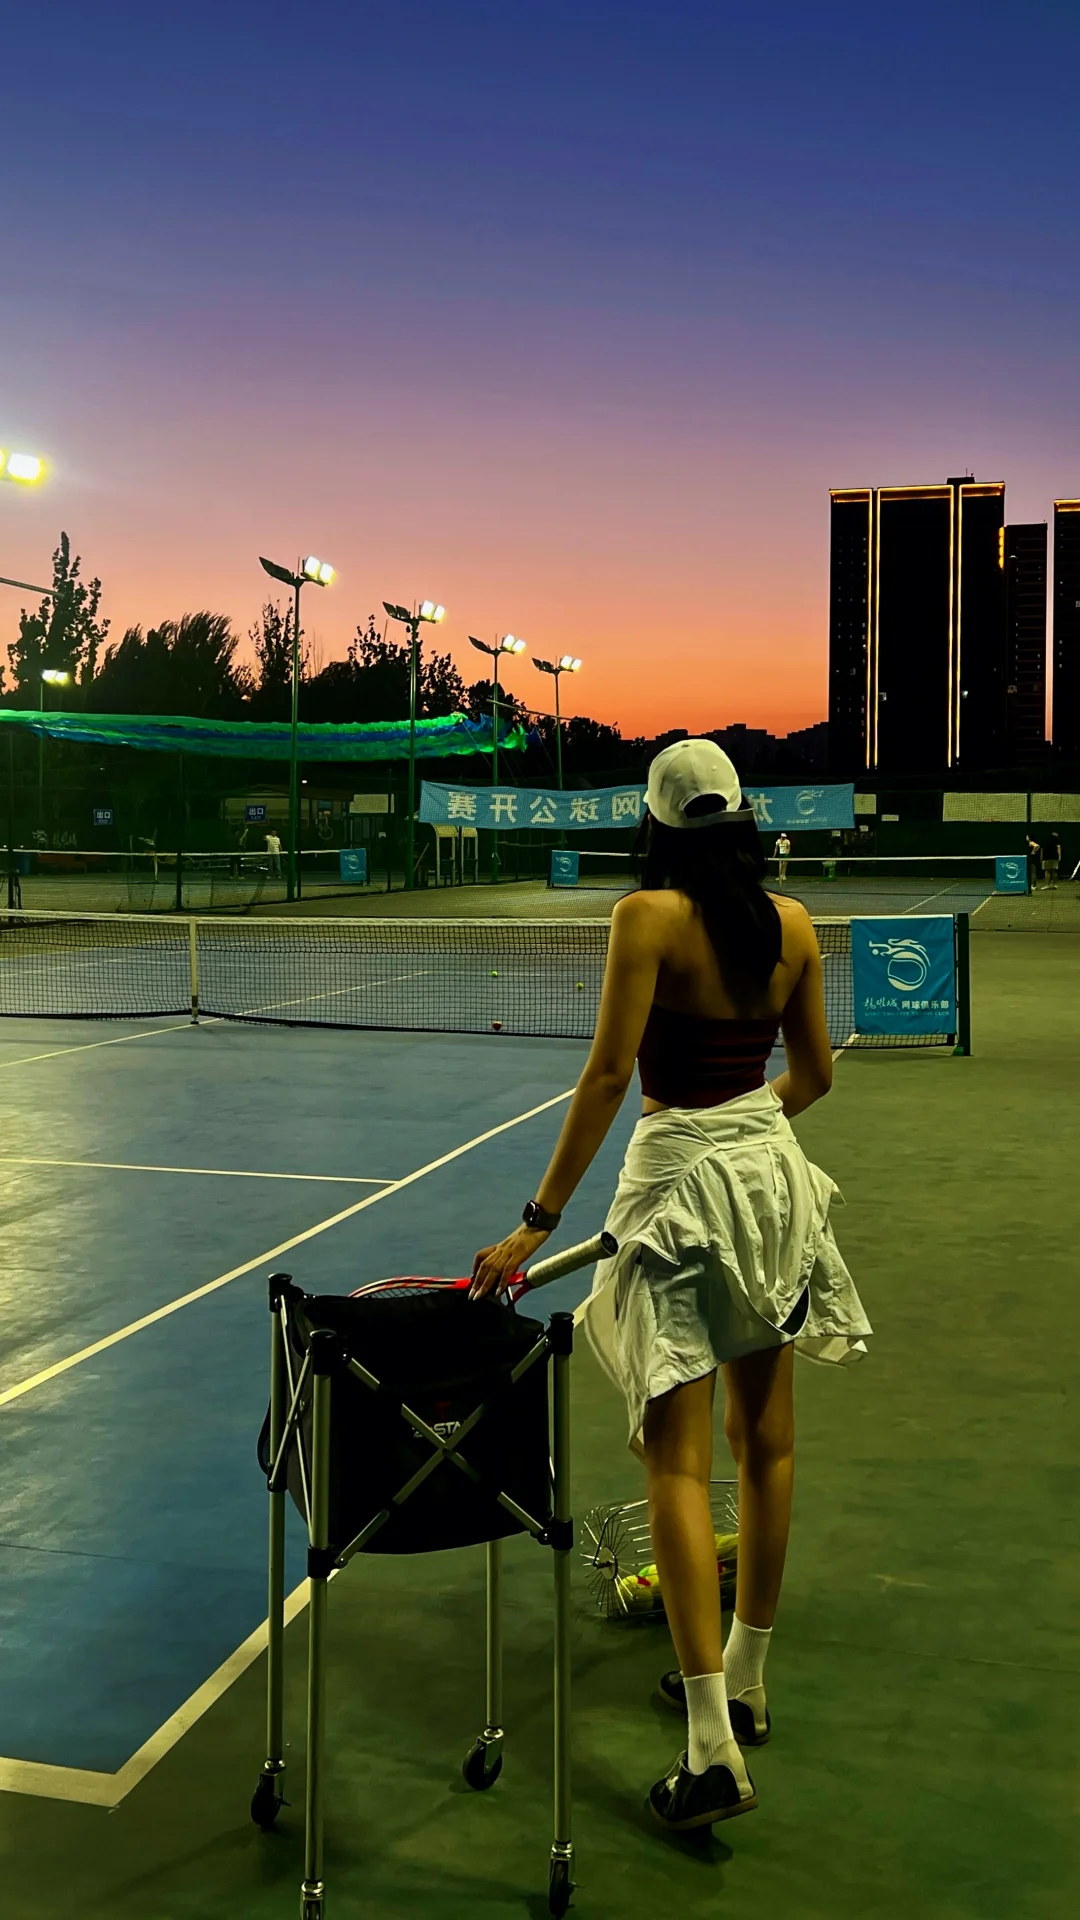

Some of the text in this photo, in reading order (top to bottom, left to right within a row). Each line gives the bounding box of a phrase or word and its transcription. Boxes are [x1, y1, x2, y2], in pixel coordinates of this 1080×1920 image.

[96, 810, 111, 819] 出口
[248, 807, 264, 815] 出口
[901, 1000, 950, 1010] 网球俱乐部
